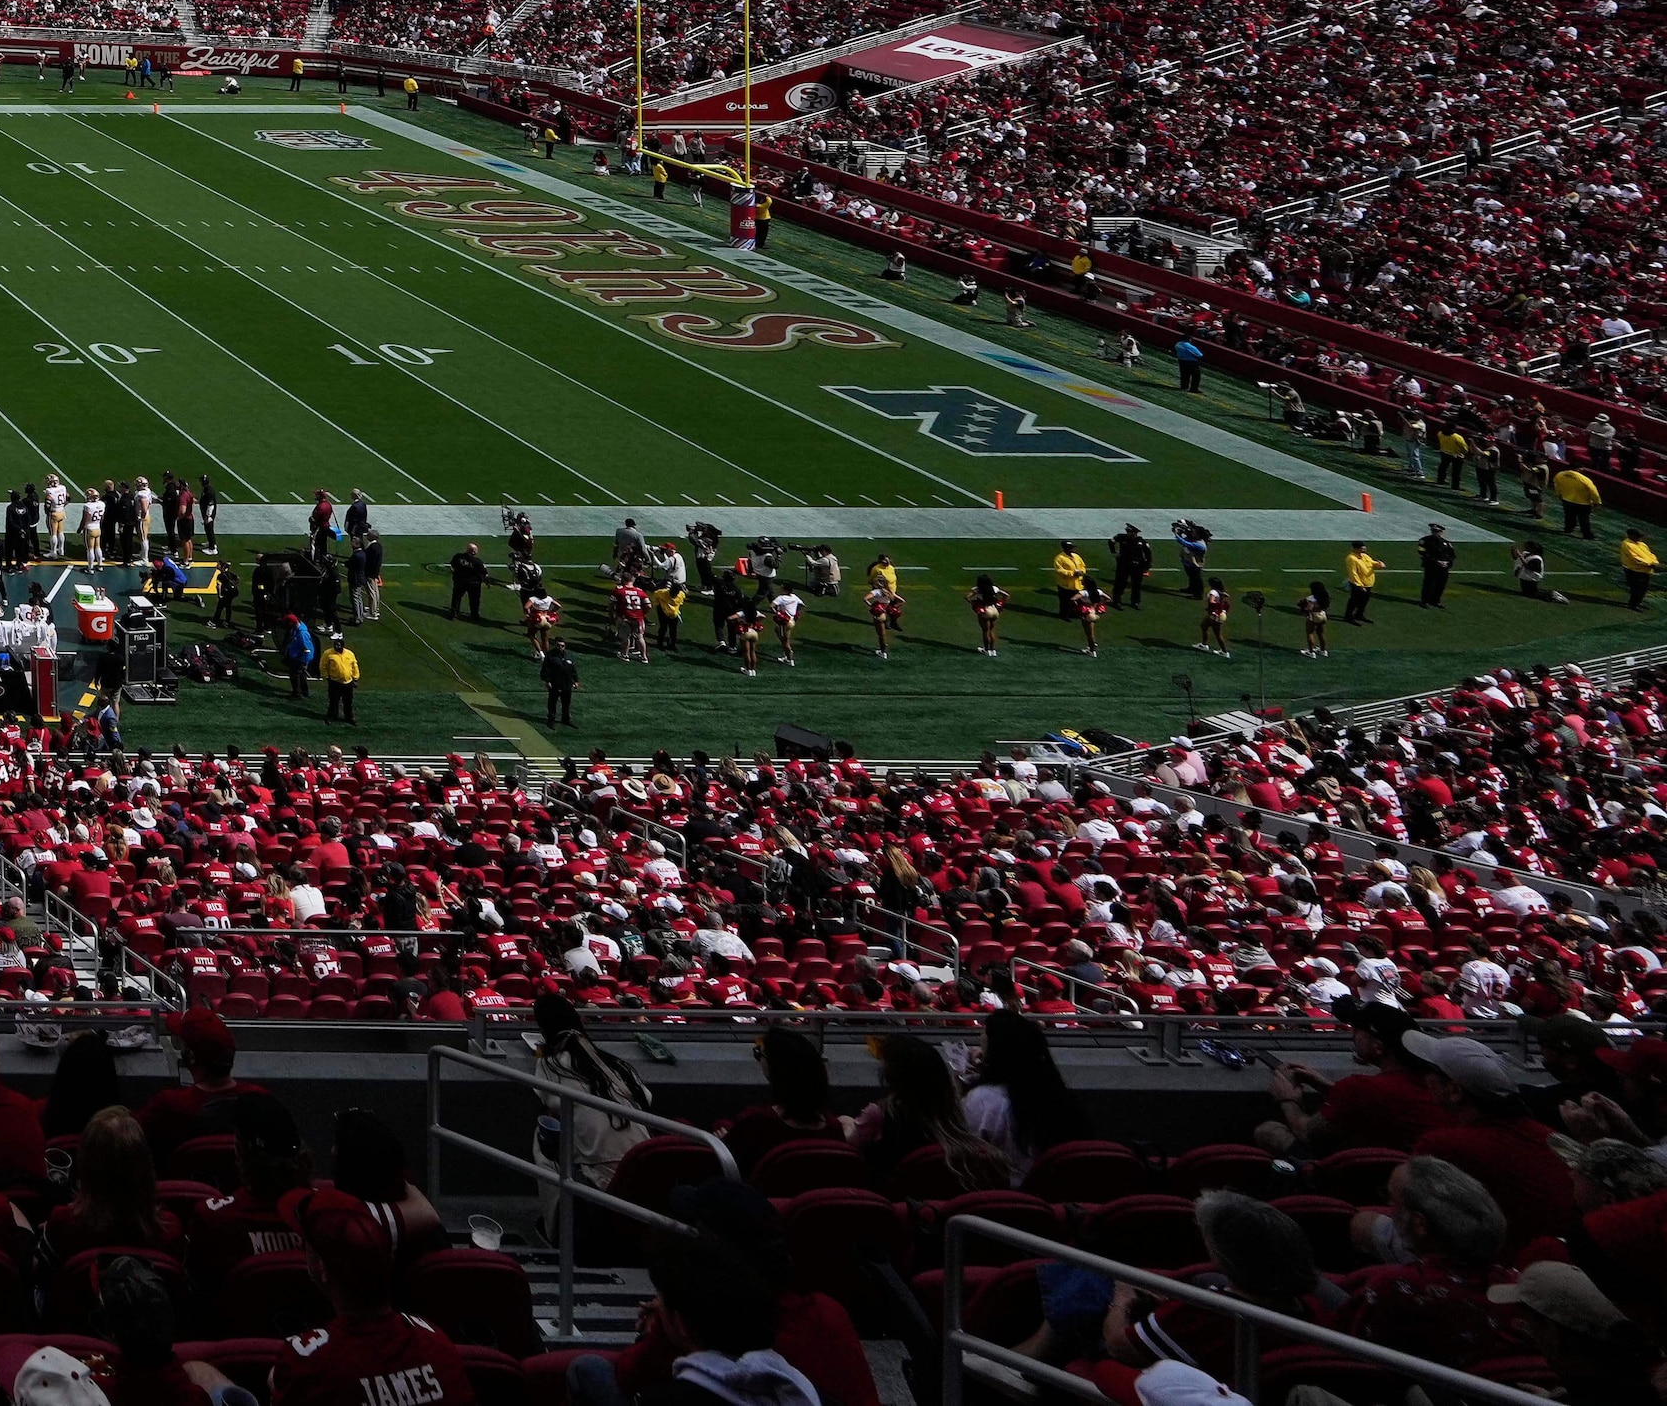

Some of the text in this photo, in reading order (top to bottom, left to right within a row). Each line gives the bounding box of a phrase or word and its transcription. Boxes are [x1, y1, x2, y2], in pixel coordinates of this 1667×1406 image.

[329, 169, 906, 352] 49ERS
[736, 258, 891, 309] CATCH
[32, 343, 139, 365] 20
[326, 343, 434, 367] 10
[91, 615, 108, 634] G
[357, 1362, 444, 1406] JAMES
